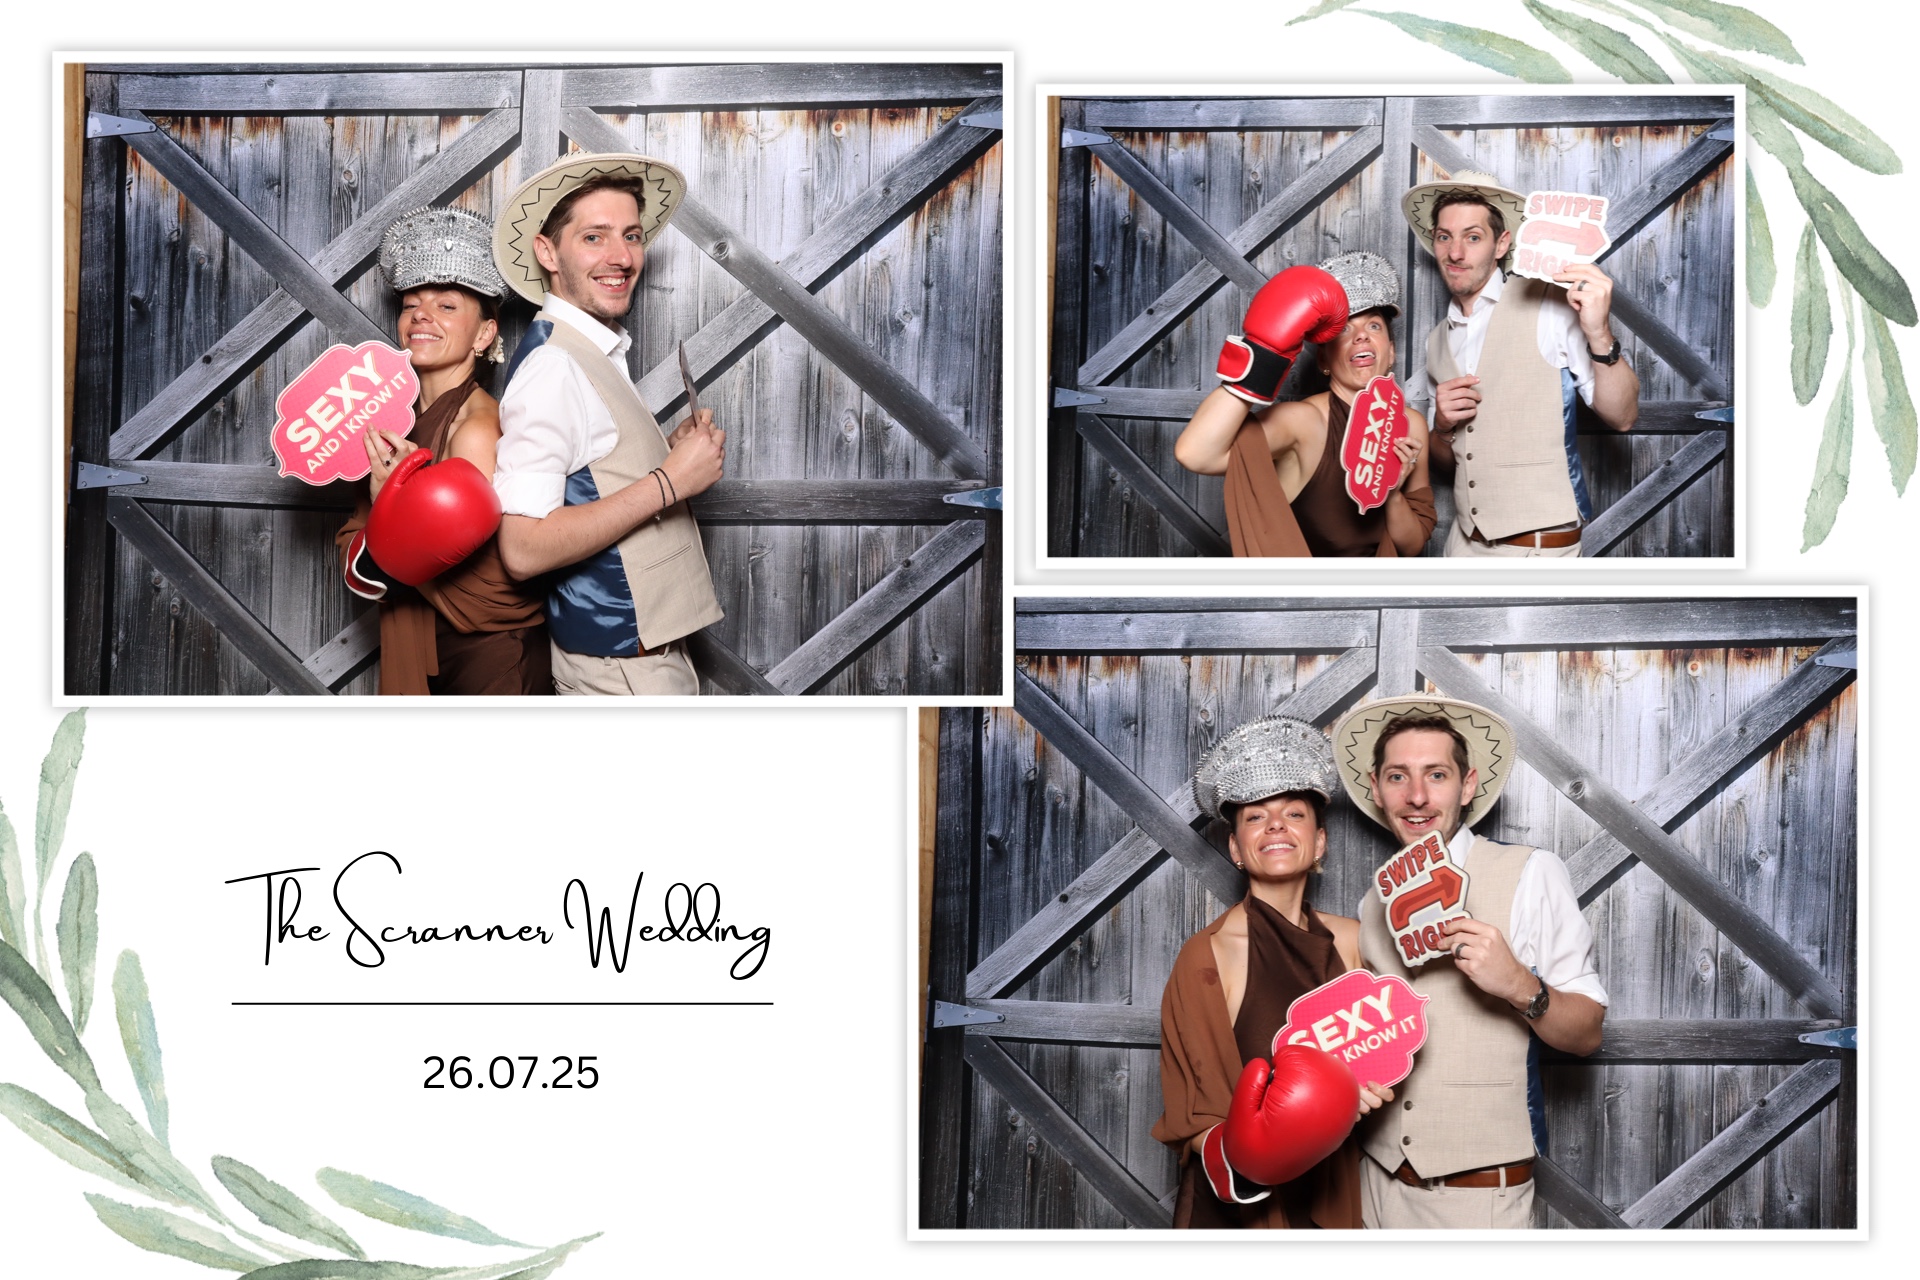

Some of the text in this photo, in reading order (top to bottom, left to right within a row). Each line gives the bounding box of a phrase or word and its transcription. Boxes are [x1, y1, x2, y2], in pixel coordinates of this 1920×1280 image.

[1528, 194, 1605, 221] SWIPE
[1517, 248, 1577, 278] RIG
[286, 350, 384, 453] SEXY
[306, 371, 407, 474] AND I KNOW IT
[1354, 386, 1388, 489] SEXY
[1371, 463, 1385, 499] AND
[1380, 406, 1397, 454] KNOW
[1391, 390, 1399, 405] IT
[1378, 835, 1445, 897] SWIPE
[1399, 916, 1466, 960] RIG
[1342, 1014, 1417, 1063] KNOW IT
